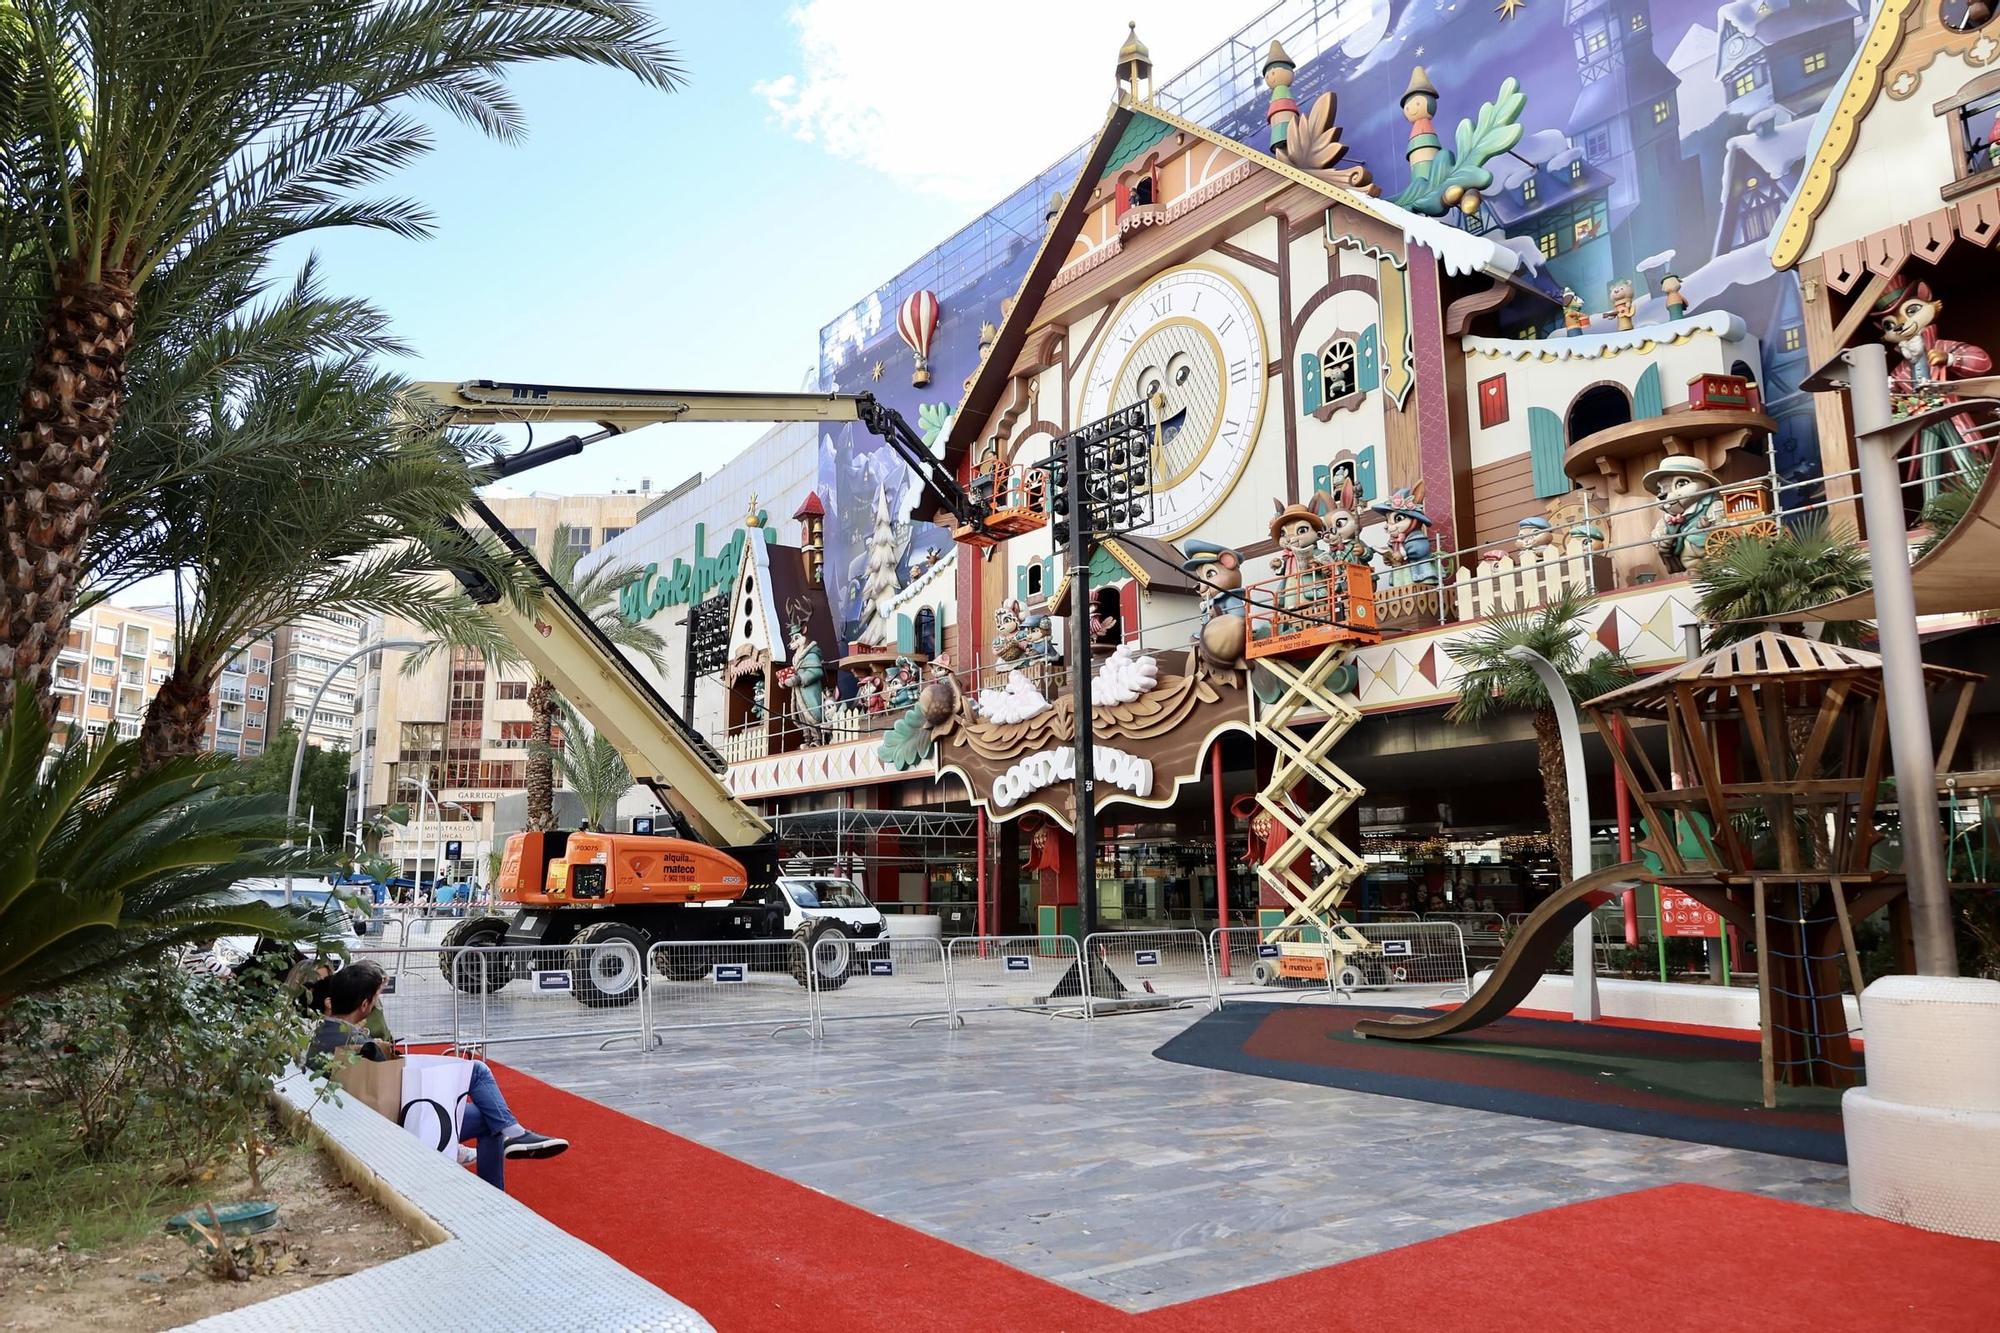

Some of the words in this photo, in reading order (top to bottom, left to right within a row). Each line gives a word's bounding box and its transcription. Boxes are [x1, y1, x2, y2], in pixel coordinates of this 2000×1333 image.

[1149, 293, 1172, 321] XII
[1217, 313, 1236, 337] II
[1230, 358, 1247, 385] III
[1221, 417, 1240, 449] IV
[1199, 470, 1214, 492] V
[640, 558, 692, 619] Corte
[993, 744, 1154, 808] CORTYLNDIA
[1304, 764, 1327, 784] mateco
[457, 791, 506, 800] GARRIGUES
[663, 865, 695, 874] mateco
